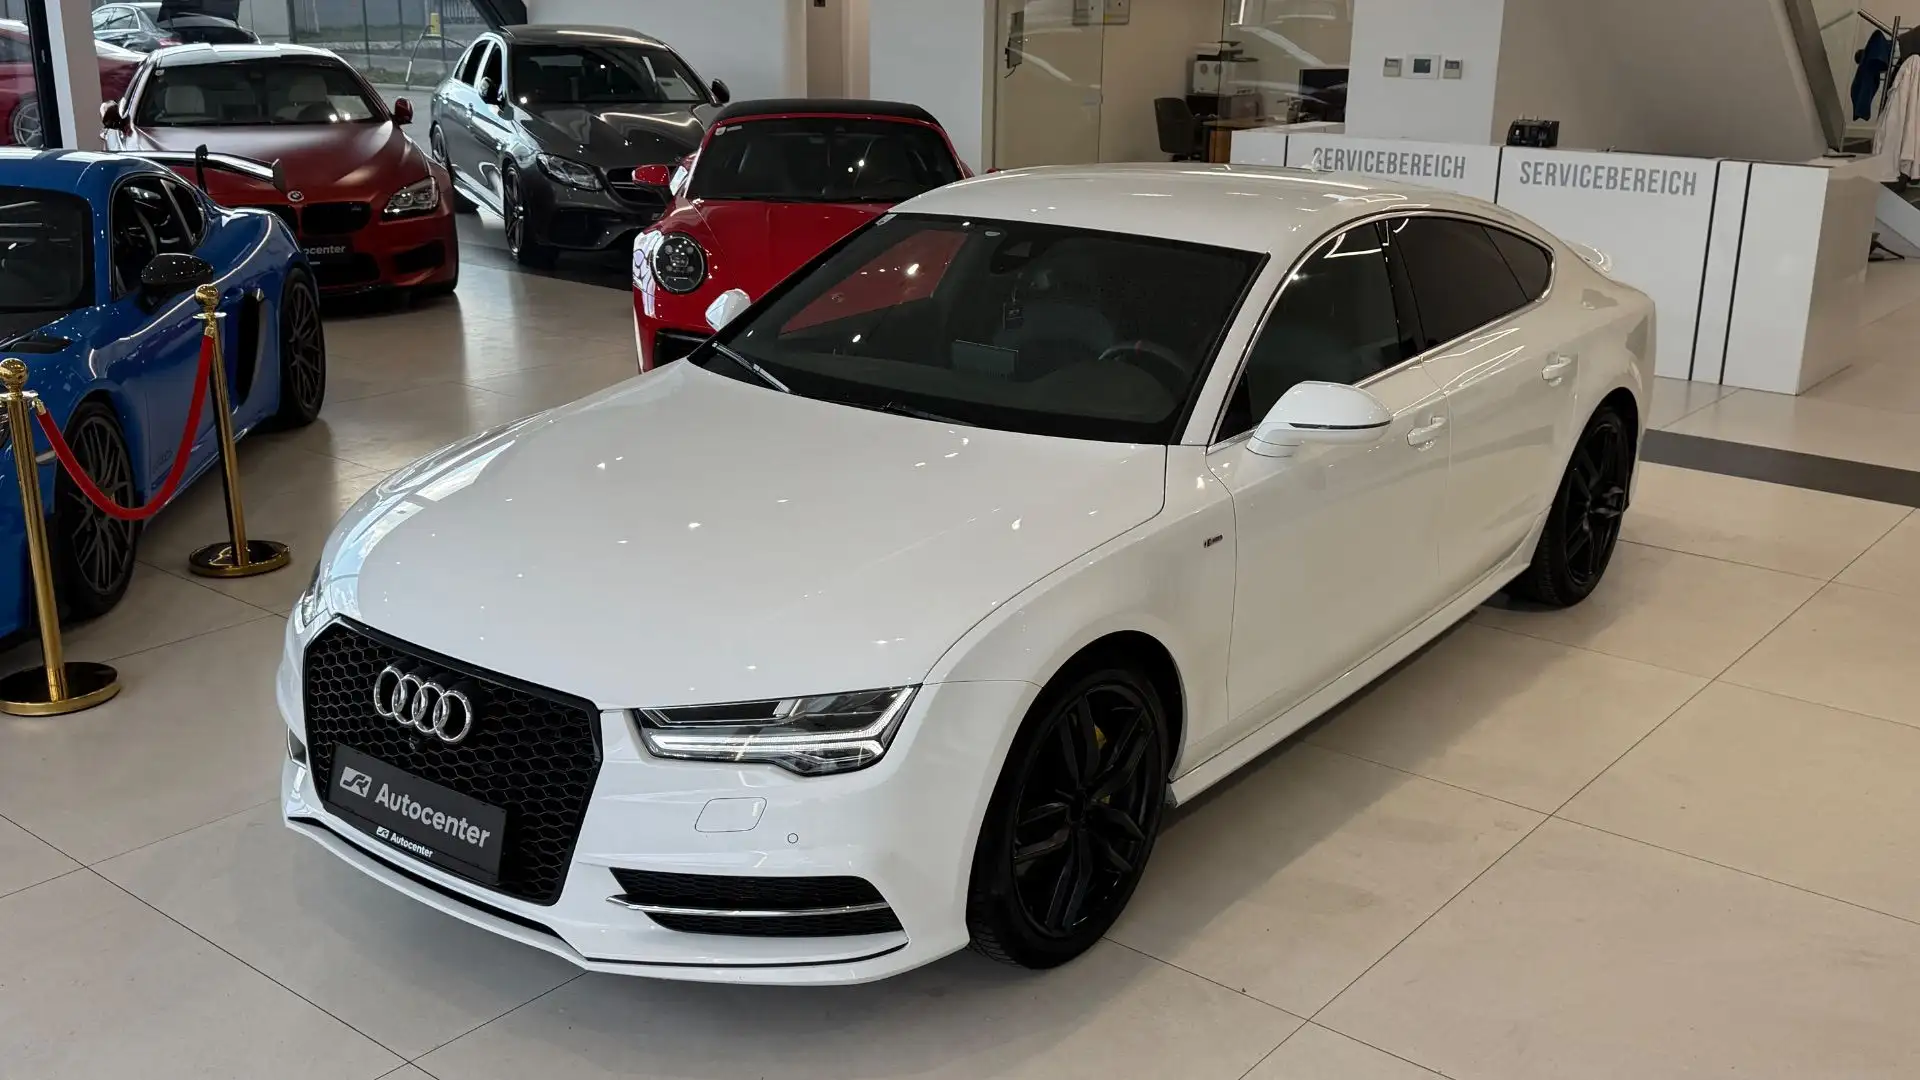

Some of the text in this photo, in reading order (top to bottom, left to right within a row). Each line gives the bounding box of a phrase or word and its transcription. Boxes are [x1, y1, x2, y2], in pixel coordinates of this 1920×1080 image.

[1519, 161, 1697, 196] SERVICEBEREICH
[303, 246, 346, 255] ocenter
[375, 783, 491, 848] Autocenter
[390, 832, 433, 858] Autocenter
